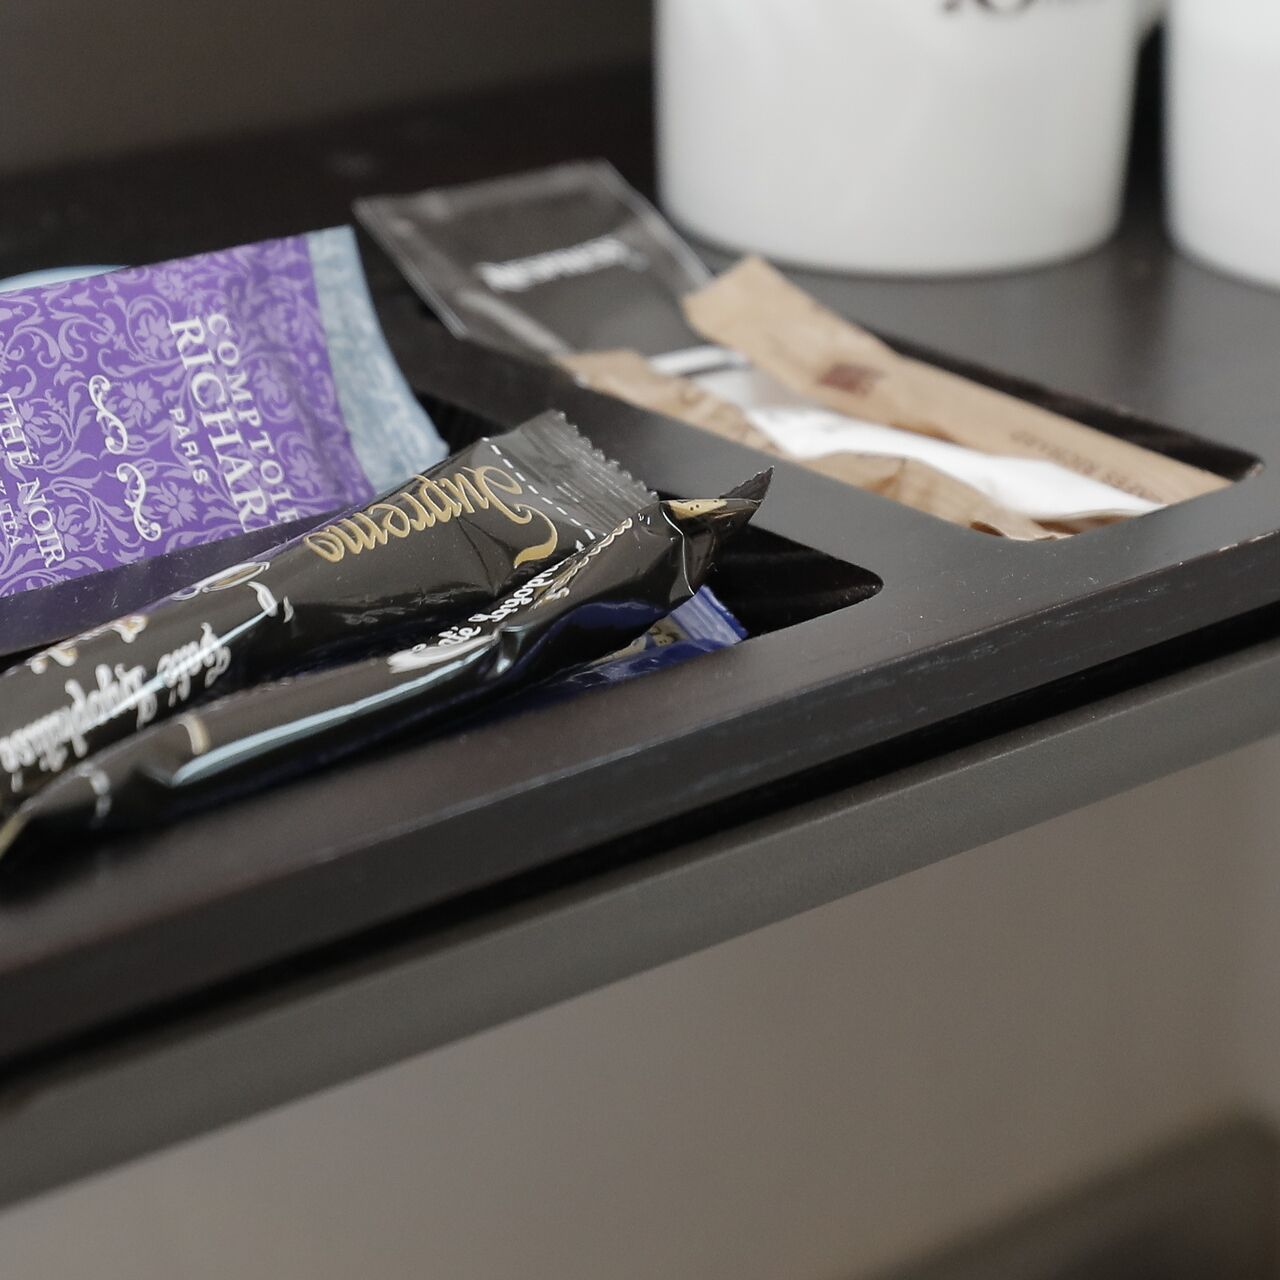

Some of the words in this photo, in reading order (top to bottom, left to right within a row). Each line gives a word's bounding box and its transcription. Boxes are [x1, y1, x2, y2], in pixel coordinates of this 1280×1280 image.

[168, 315, 271, 534] RICHAR
[169, 407, 209, 485] PARIS
[17, 477, 66, 568] NOIR
[303, 465, 558, 569] Supremo
